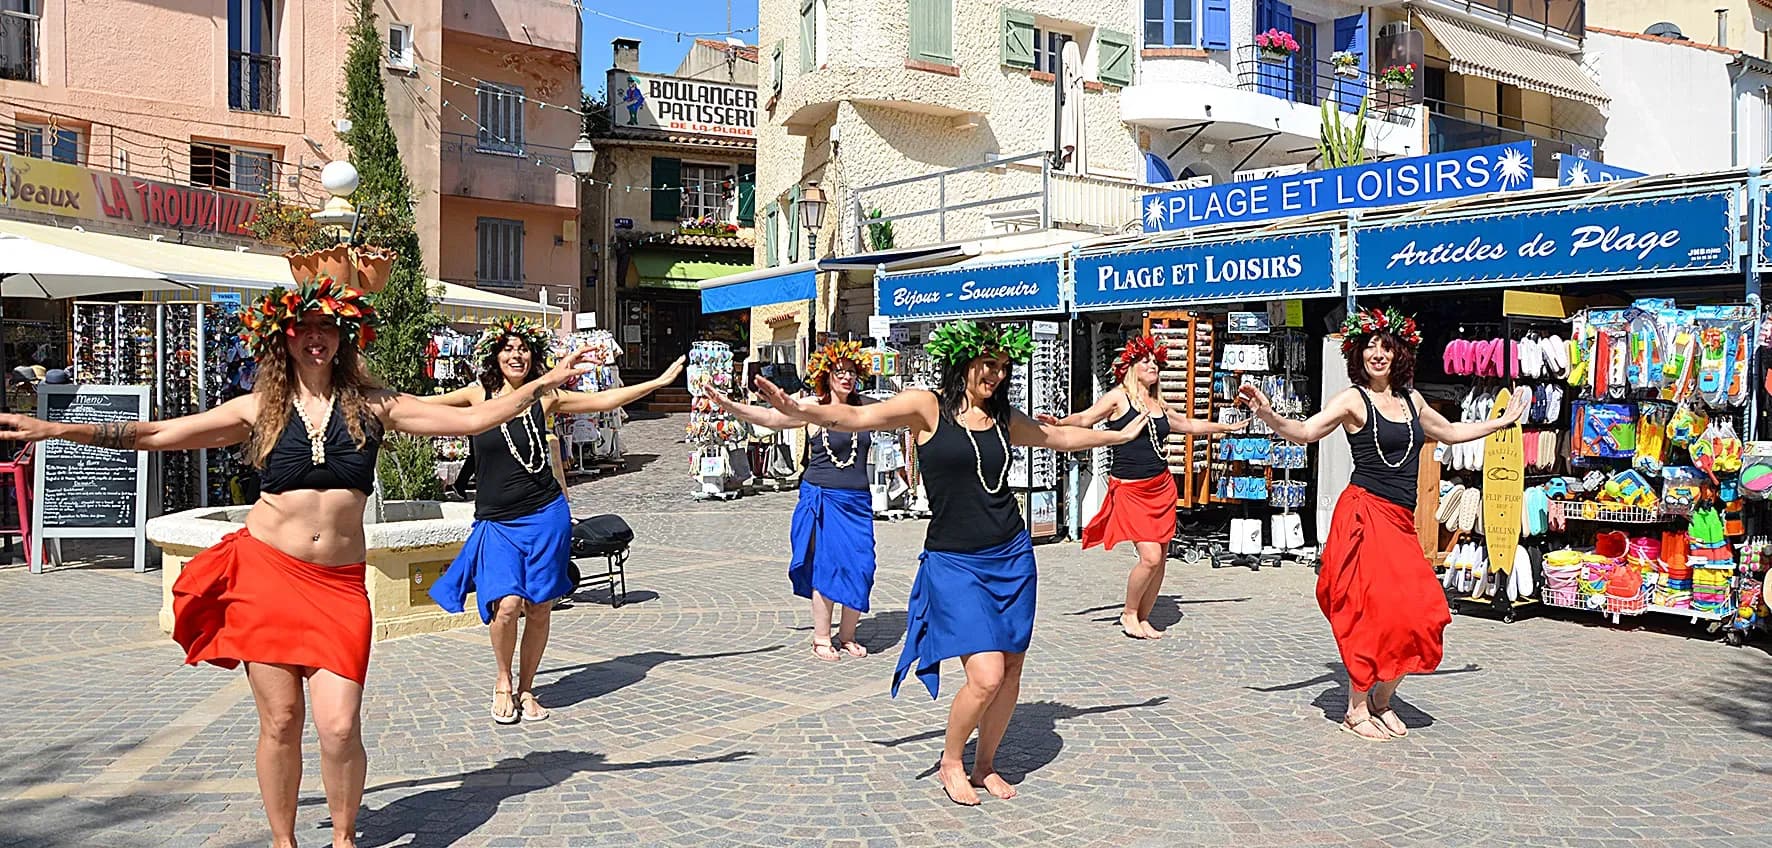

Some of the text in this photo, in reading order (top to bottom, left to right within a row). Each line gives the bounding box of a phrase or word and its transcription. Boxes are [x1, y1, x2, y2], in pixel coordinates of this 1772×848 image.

[649, 80, 757, 108] BOULANGER
[658, 101, 758, 127] PATISSERI
[670, 121, 753, 136] DE LA PLAGE
[91, 173, 131, 219] LA
[1168, 155, 1490, 224] PLAGE ET LOISIRS
[1386, 225, 1680, 269] Articles de Plage
[1097, 255, 1302, 291] PLAGE ET LOISIRS
[893, 287, 941, 311] Bijoux
[959, 281, 1040, 301] Souvenirs
